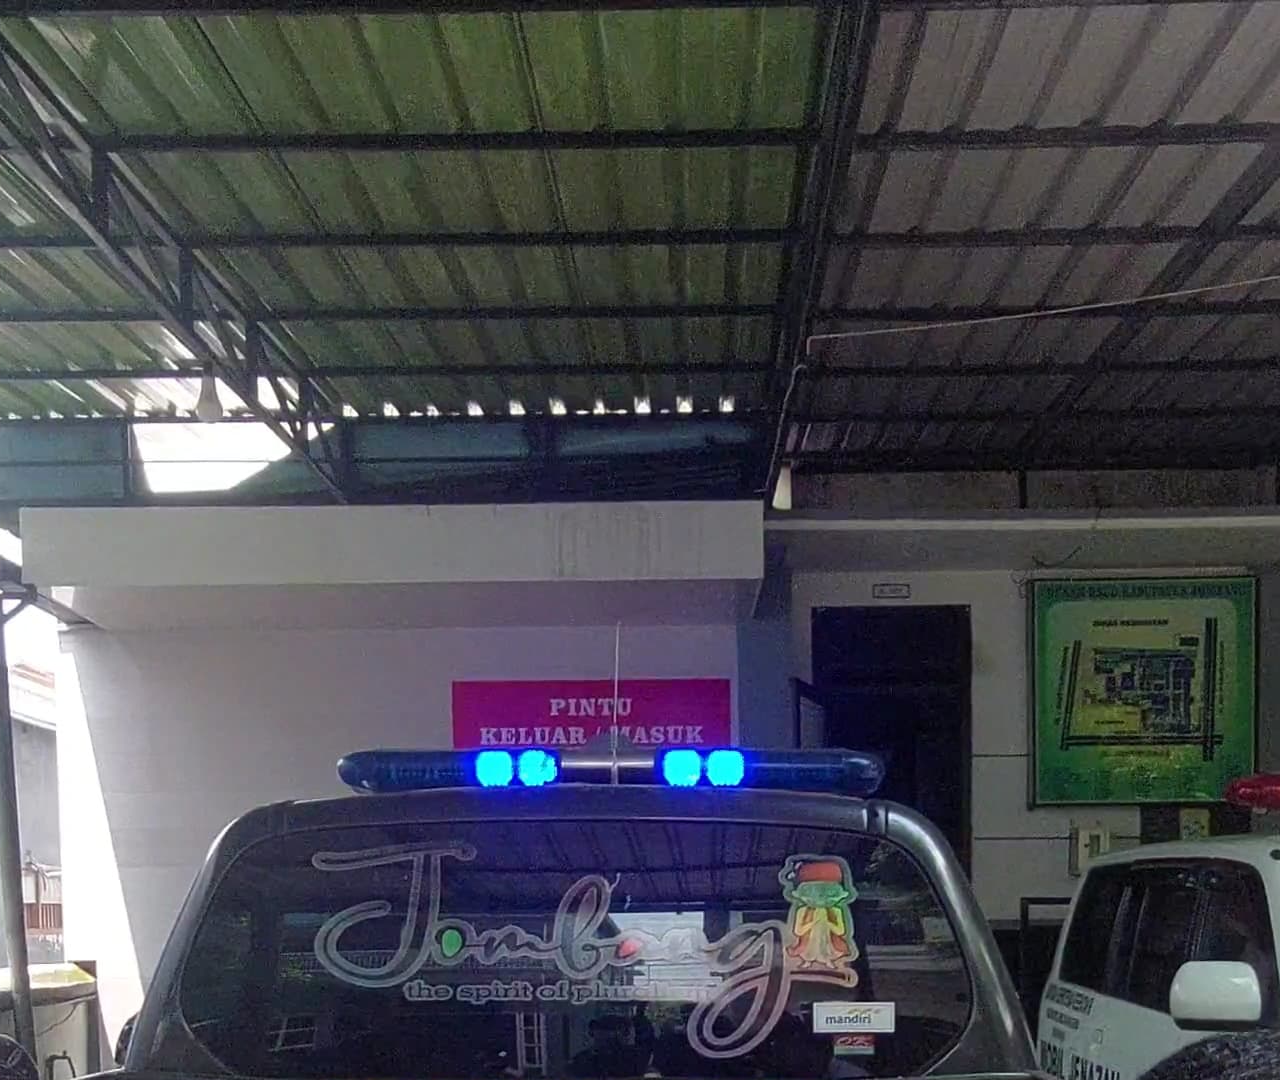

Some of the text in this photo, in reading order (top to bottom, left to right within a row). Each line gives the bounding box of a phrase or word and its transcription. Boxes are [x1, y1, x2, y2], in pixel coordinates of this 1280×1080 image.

[549, 697, 633, 717] PINTU
[479, 726, 588, 746] KELUAR
[405, 980, 451, 1002] the
[457, 980, 531, 1003] spirit
[537, 980, 568, 1002] of
[825, 1015, 872, 1024] mandiri
